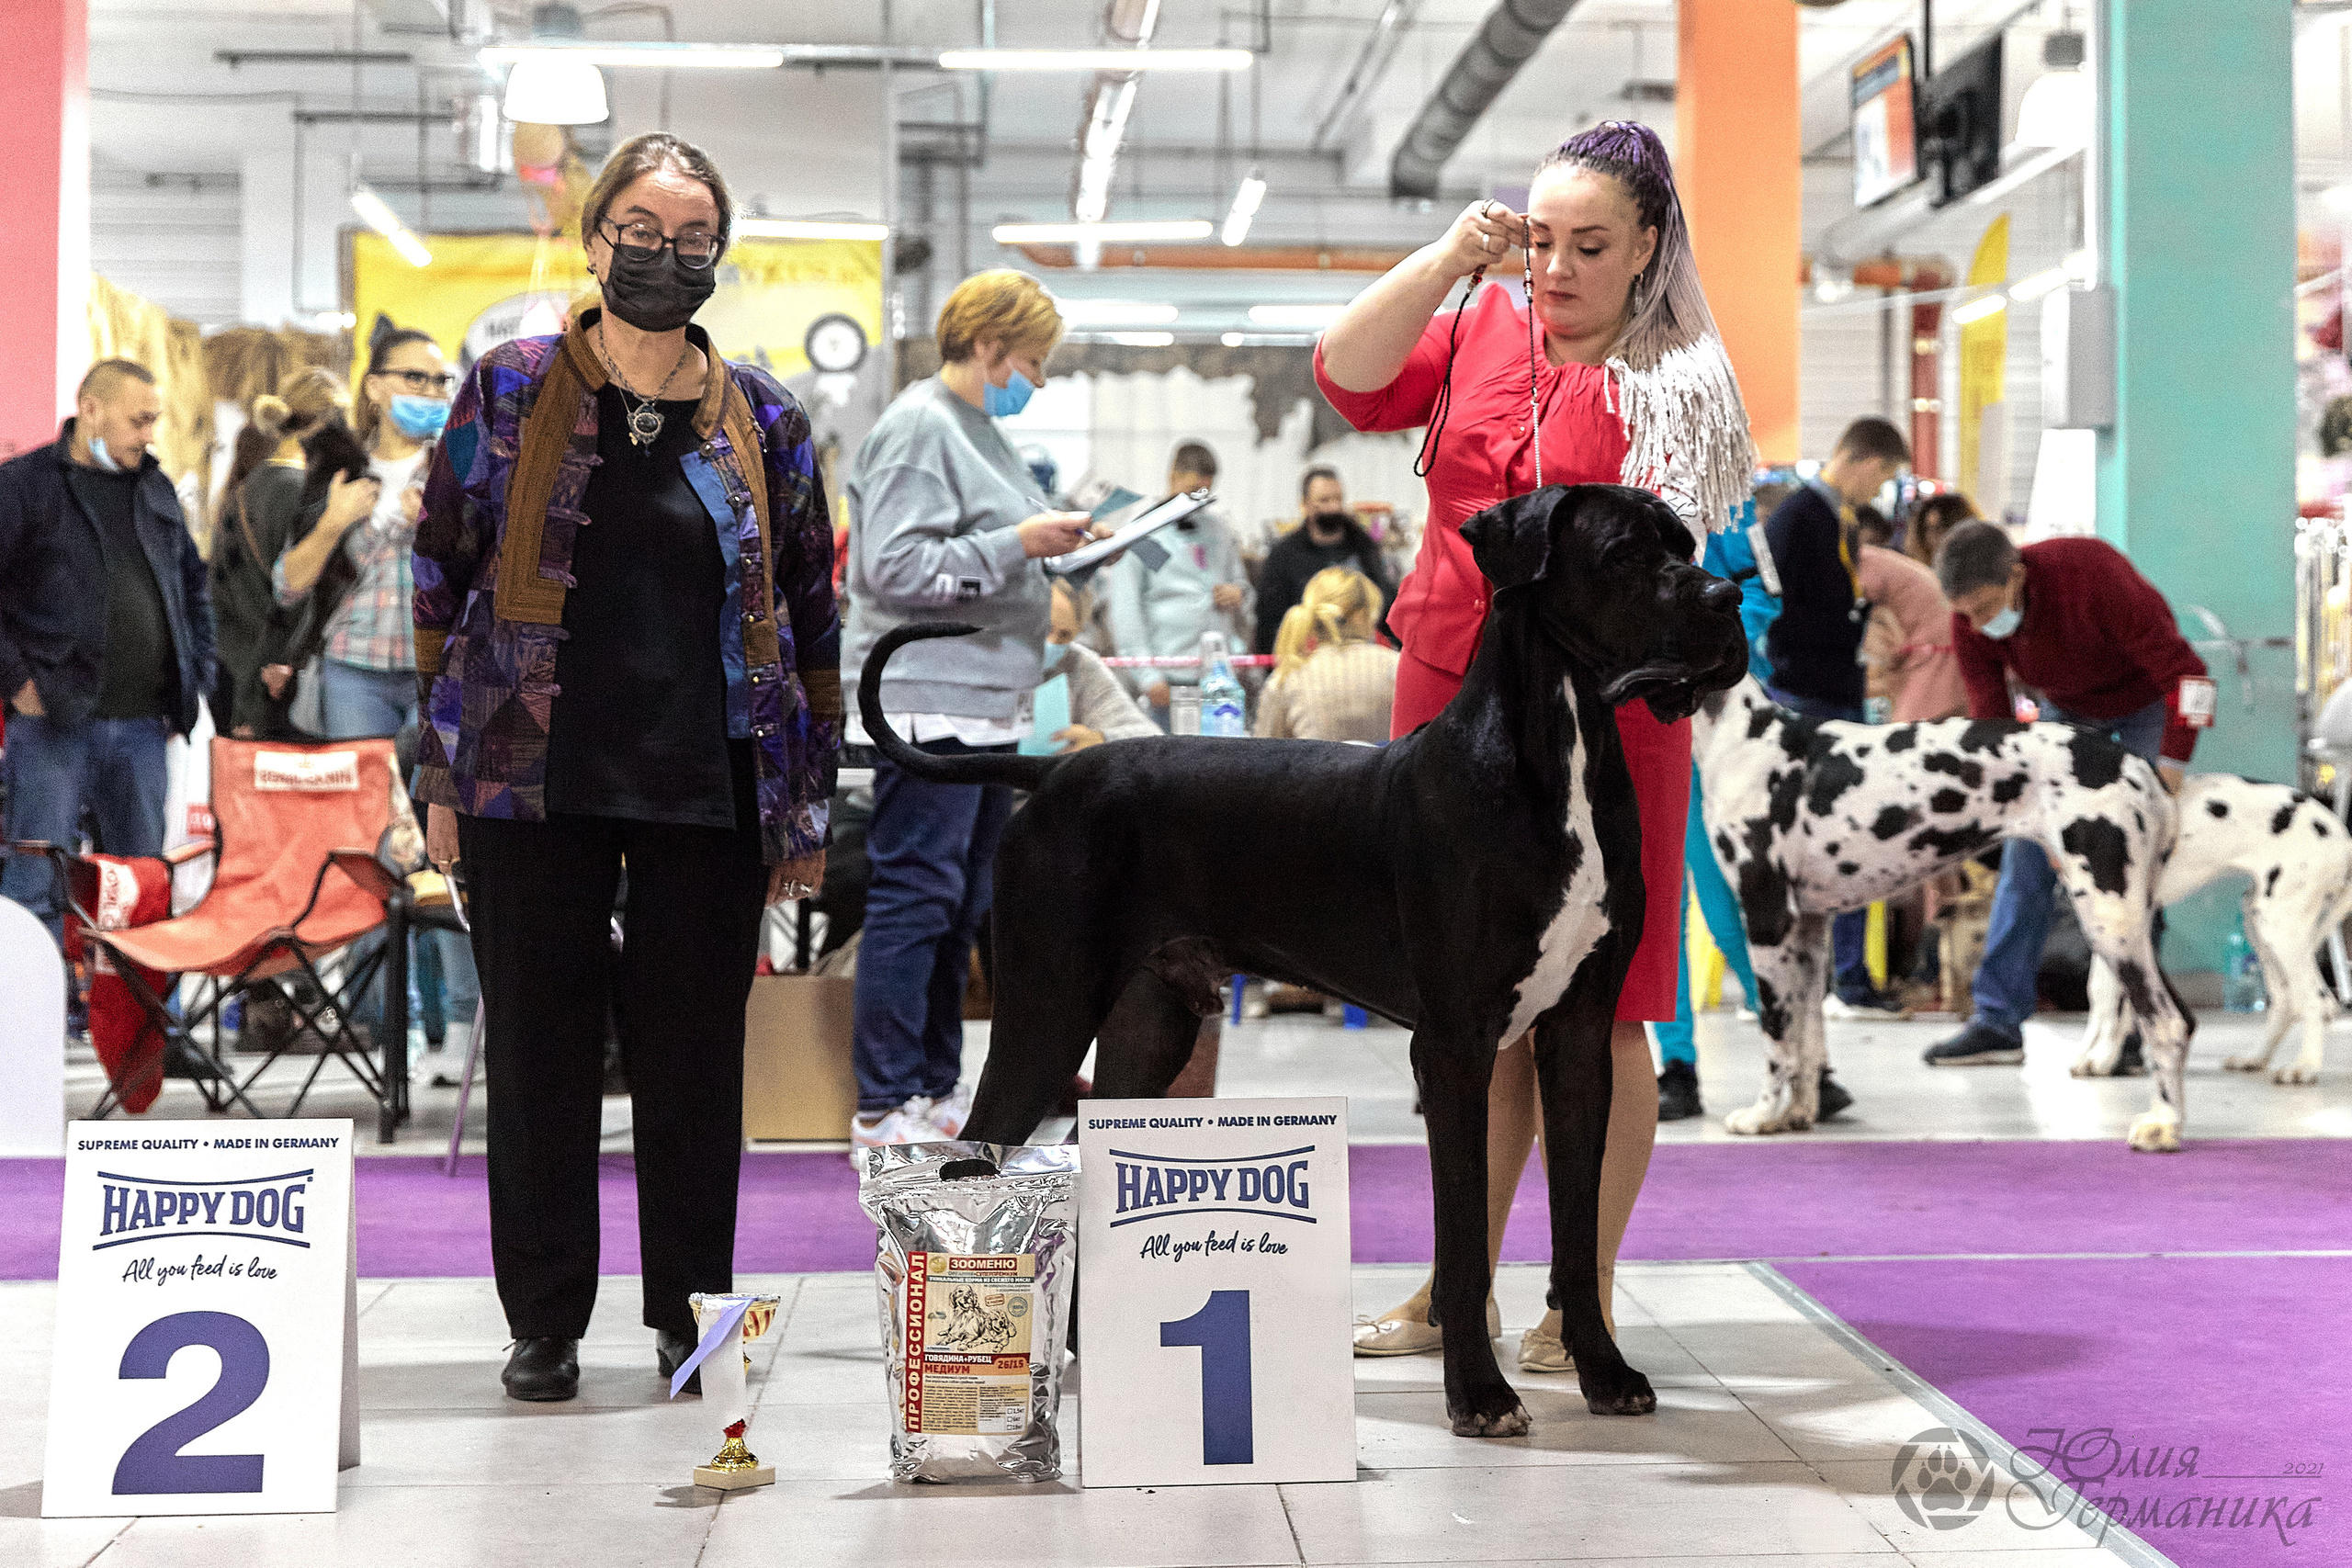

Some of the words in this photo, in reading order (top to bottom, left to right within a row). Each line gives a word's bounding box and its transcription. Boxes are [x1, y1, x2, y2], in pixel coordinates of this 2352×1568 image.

[1088, 1118, 1147, 1130] SUPREME
[1148, 1117, 1204, 1129] QUALITY
[1217, 1115, 1254, 1127] MADE
[1257, 1115, 1271, 1126] IN
[1273, 1114, 1338, 1126] GERMANY
[77, 1140, 139, 1151] SUPREME
[141, 1138, 198, 1150] QUALITY
[213, 1138, 252, 1149] MADE
[254, 1138, 269, 1148] IN
[272, 1137, 340, 1149] GERMANY
[1114, 1161, 1233, 1214] HAPPY
[1238, 1159, 1309, 1210] DOG
[99, 1184, 226, 1236] HAPPY
[229, 1183, 306, 1234] DOG
[1139, 1233, 1170, 1259] All
[1173, 1240, 1203, 1262] you
[1204, 1230, 1238, 1257] feed
[1240, 1237, 1255, 1253] is
[1259, 1232, 1288, 1255] love
[122, 1258, 153, 1282] All
[156, 1264, 187, 1286] you
[190, 1254, 227, 1280] feed
[229, 1261, 243, 1275] is
[247, 1257, 278, 1280] love
[951, 1259, 1015, 1269] ЗООМЕНЮ
[908, 1254, 924, 1429] ПРОФЕССИОНАЛ
[924, 1364, 970, 1374] МЕДИУМ
[998, 1359, 1023, 1369] 26/15
[1160, 1290, 1253, 1465] 1
[111, 1311, 270, 1495] 2
